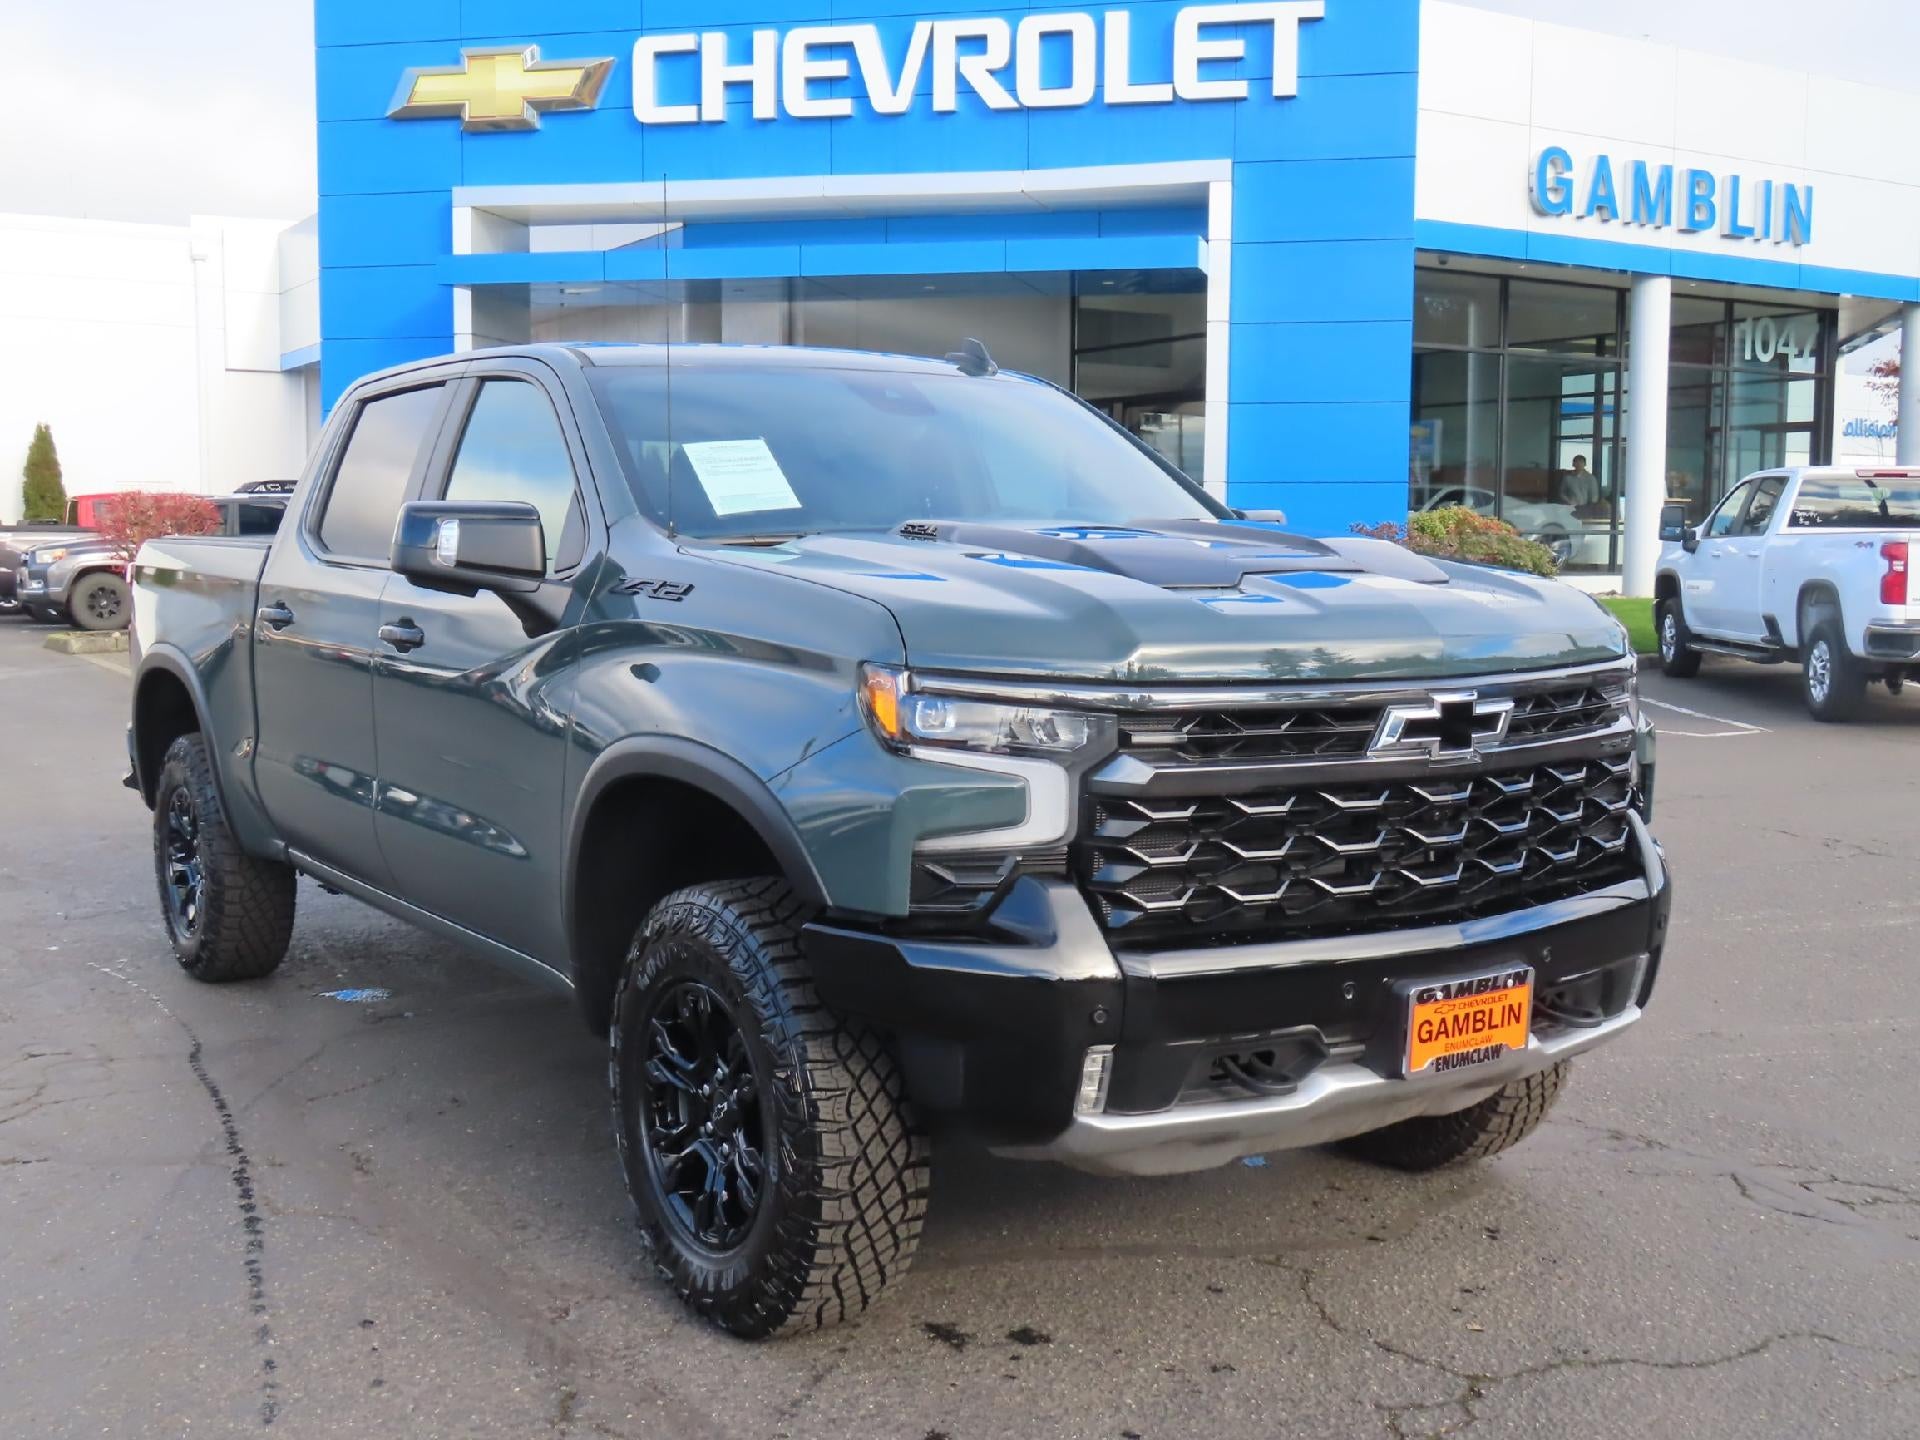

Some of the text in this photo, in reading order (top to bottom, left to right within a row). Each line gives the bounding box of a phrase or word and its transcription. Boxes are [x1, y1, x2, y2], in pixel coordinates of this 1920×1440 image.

[632, 0, 1325, 125] CHEVROLET
[1530, 146, 1814, 247] GAMBLIN
[1416, 969, 1529, 1005] GAMBLIN
[1457, 993, 1509, 1010] CHEVROLET
[1417, 1002, 1522, 1044] GAMBLIN
[1434, 1043, 1504, 1073] ENUMCLAW
[1444, 1034, 1494, 1053] ENUMCLAW
